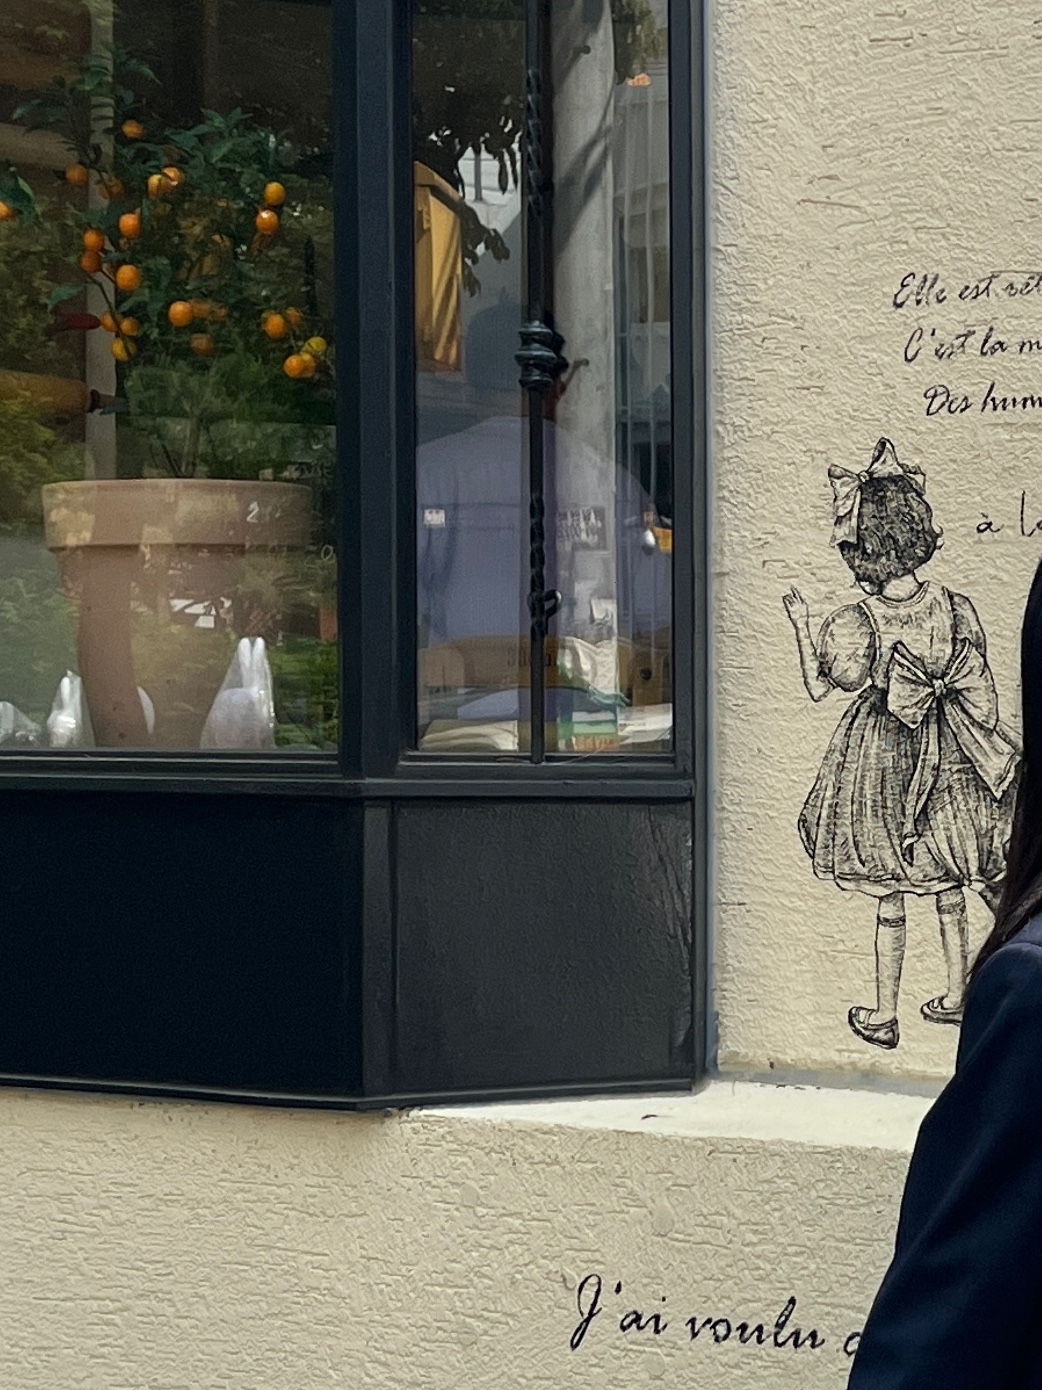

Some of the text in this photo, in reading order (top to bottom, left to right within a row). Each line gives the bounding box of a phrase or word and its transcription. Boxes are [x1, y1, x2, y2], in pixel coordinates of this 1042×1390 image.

[892, 272, 948, 310] Elle
[958, 270, 998, 301] est
[904, 327, 976, 363] C'est
[980, 326, 1007, 357] la
[923, 384, 972, 416] Des
[976, 512, 1004, 535] à
[570, 1273, 669, 1351] J'ai
[685, 1297, 827, 1350] voulu
